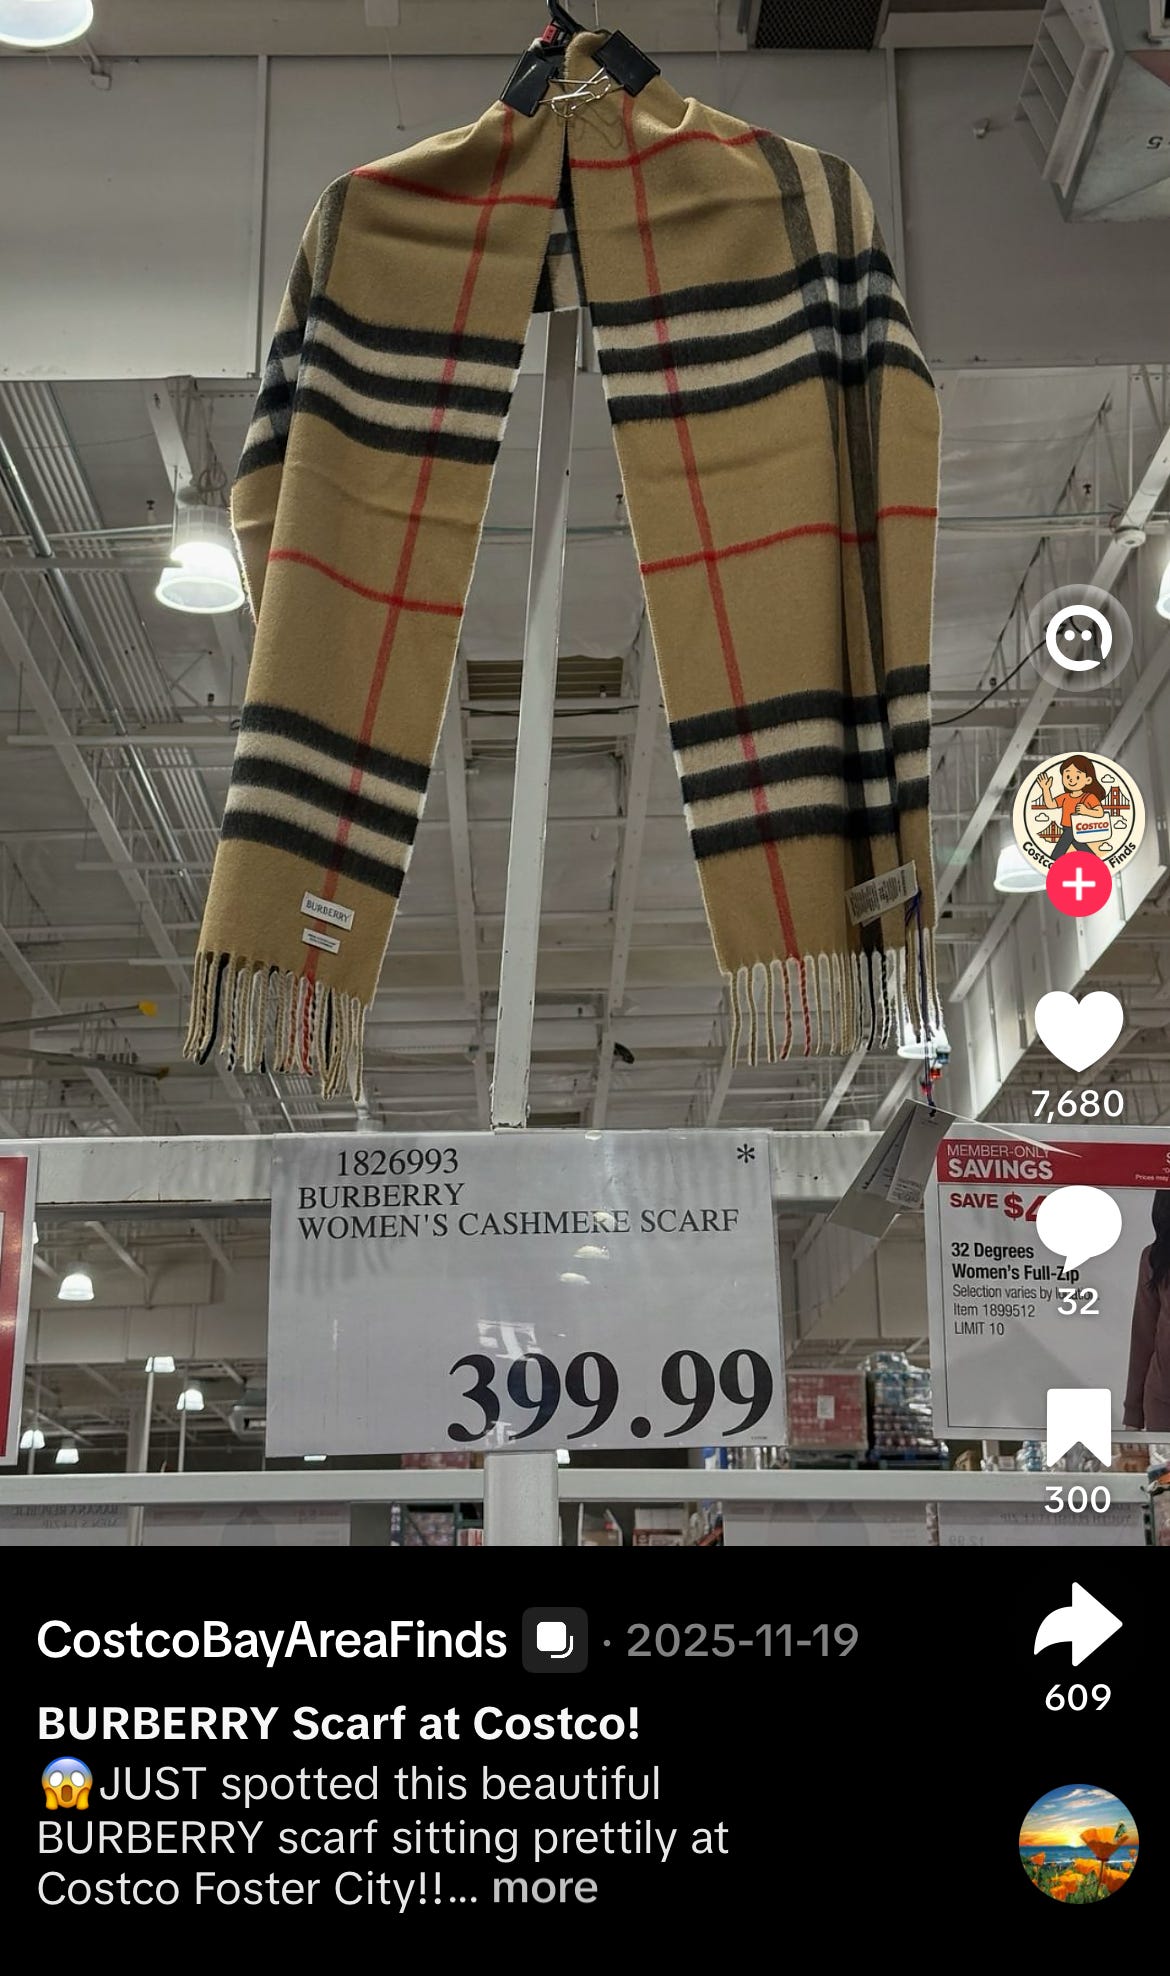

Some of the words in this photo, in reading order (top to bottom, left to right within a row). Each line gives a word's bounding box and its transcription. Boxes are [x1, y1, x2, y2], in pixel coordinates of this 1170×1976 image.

[306, 899, 351, 922] BURBERRY
[947, 1144, 1049, 1158] MEMBER-ONLY
[338, 1148, 458, 1176] 1826993
[948, 1158, 1053, 1179] SAVINGS
[298, 1183, 465, 1210] BURBERRY
[950, 1193, 998, 1208] SAVE
[298, 1213, 448, 1240] WOMEN'S
[458, 1210, 632, 1236] CASHMERE
[640, 1209, 739, 1233] SCARF
[951, 1242, 970, 1257] 32
[974, 1242, 1034, 1261] Degrees
[952, 1263, 1020, 1280] Women's
[953, 1284, 1002, 1298] Selection
[1005, 1285, 1037, 1299] varies
[1040, 1286, 1052, 1302] by
[954, 1303, 978, 1316] Item
[983, 1304, 1036, 1317] 1899512
[954, 1321, 985, 1335] LIMIT
[990, 1322, 1005, 1335] 10
[447, 1349, 774, 1443] 399.99
